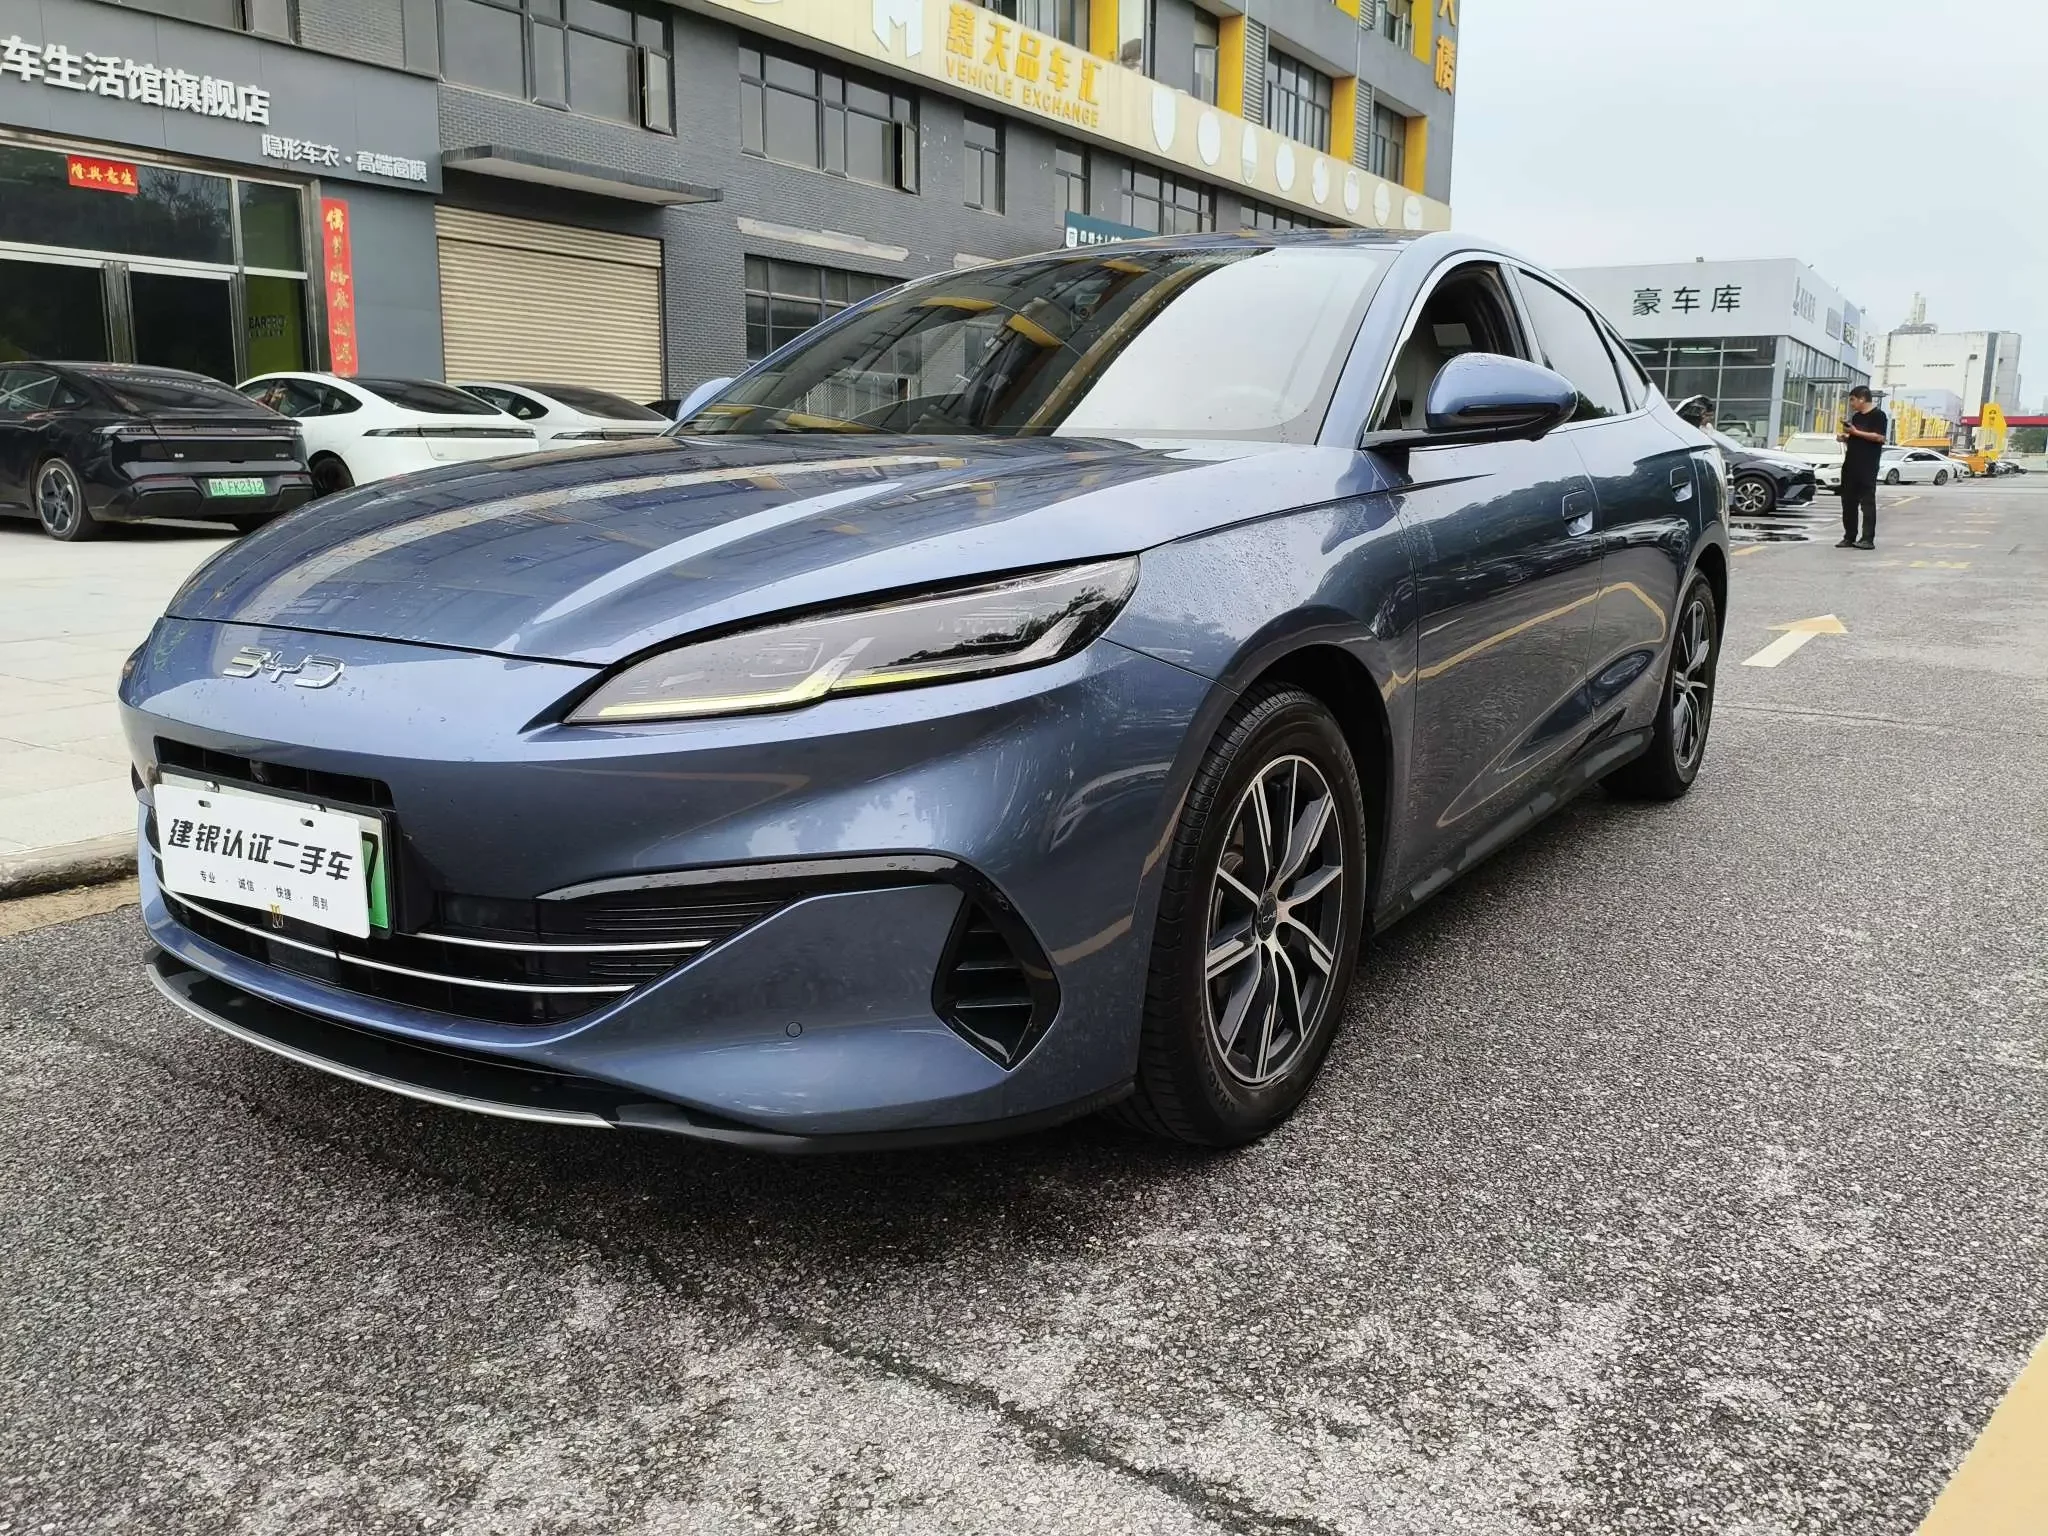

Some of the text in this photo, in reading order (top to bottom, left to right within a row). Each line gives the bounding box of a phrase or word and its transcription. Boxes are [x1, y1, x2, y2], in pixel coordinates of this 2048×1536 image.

[0, 35, 271, 126] 车生活馆旗舰店
[945, 55, 1099, 129] VEHICLE EXCHANGE
[1633, 284, 1742, 316] 豪车库
[223, 645, 345, 689] BYD
[168, 818, 353, 881] 建银认证二手车
[200, 870, 216, 884] 专业
[238, 877, 255, 892] 诚信
